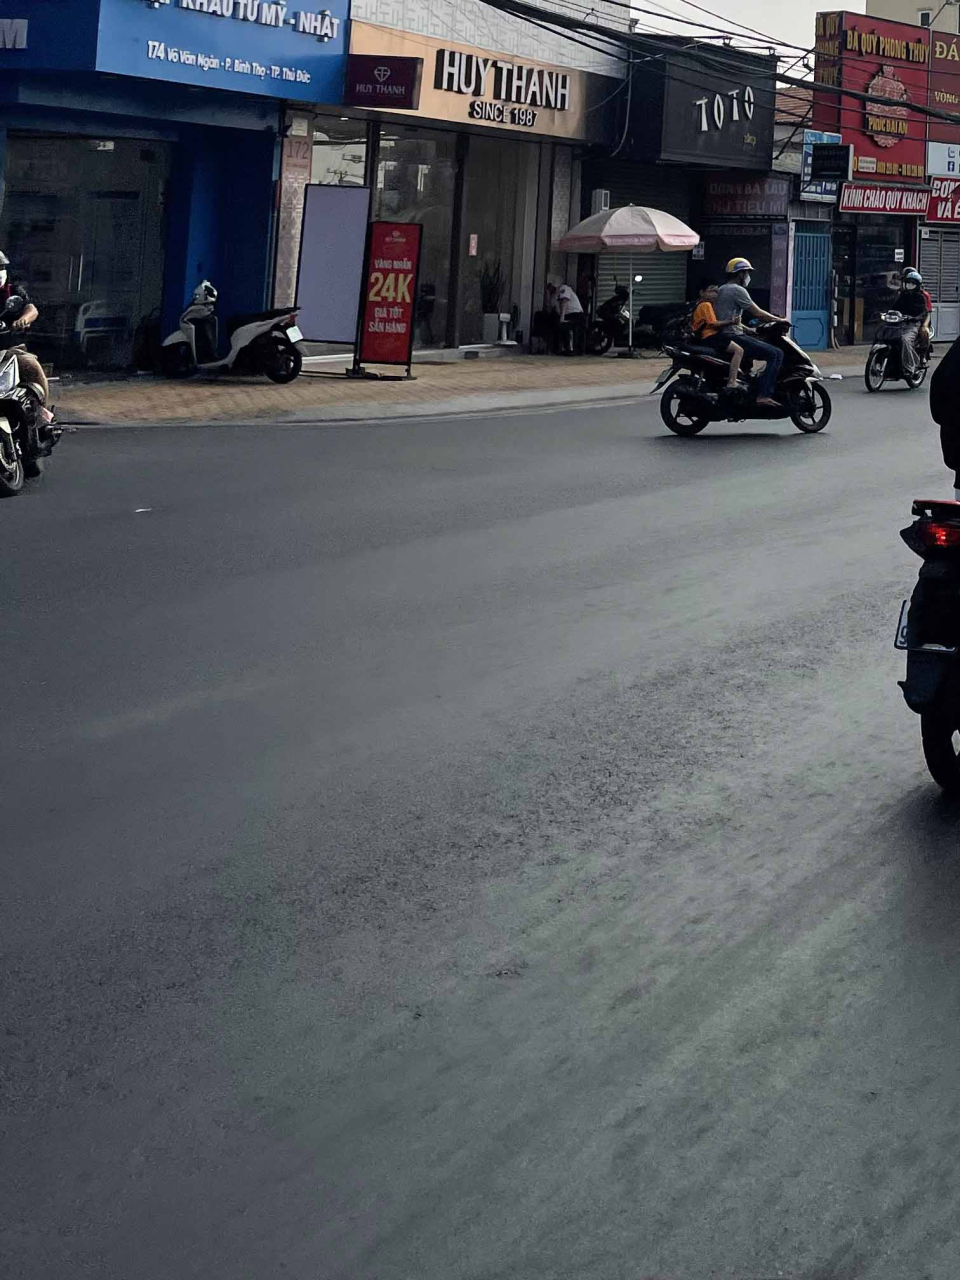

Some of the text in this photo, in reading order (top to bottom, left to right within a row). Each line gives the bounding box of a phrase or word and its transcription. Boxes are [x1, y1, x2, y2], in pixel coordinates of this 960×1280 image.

[261, 1, 287, 27] MỸ
[295, 8, 340, 43] NHẬT
[861, 30, 878, 55] QUÝ
[879, 35, 907, 61] PHONG
[934, 38, 960, 61] ĐÁ
[147, 40, 165, 60] 174
[167, 48, 179, 62] Võ
[180, 50, 195, 66] Văn
[252, 62, 265, 80] Thọ
[271, 65, 280, 79] TP.
[282, 67, 295, 81] Thủ
[296, 69, 311, 83] Đức
[356, 83, 405, 95] HUY THANH
[436, 48, 571, 110] HUY THANH
[470, 101, 538, 126] SINCE 1987
[694, 86, 754, 132] TOTO
[288, 141, 308, 159] 172
[842, 185, 863, 207] KÍNH
[864, 187, 886, 208] CHÀO
[886, 188, 902, 211] QUÝ
[936, 199, 952, 218] VÁ
[369, 272, 413, 303] 24K
